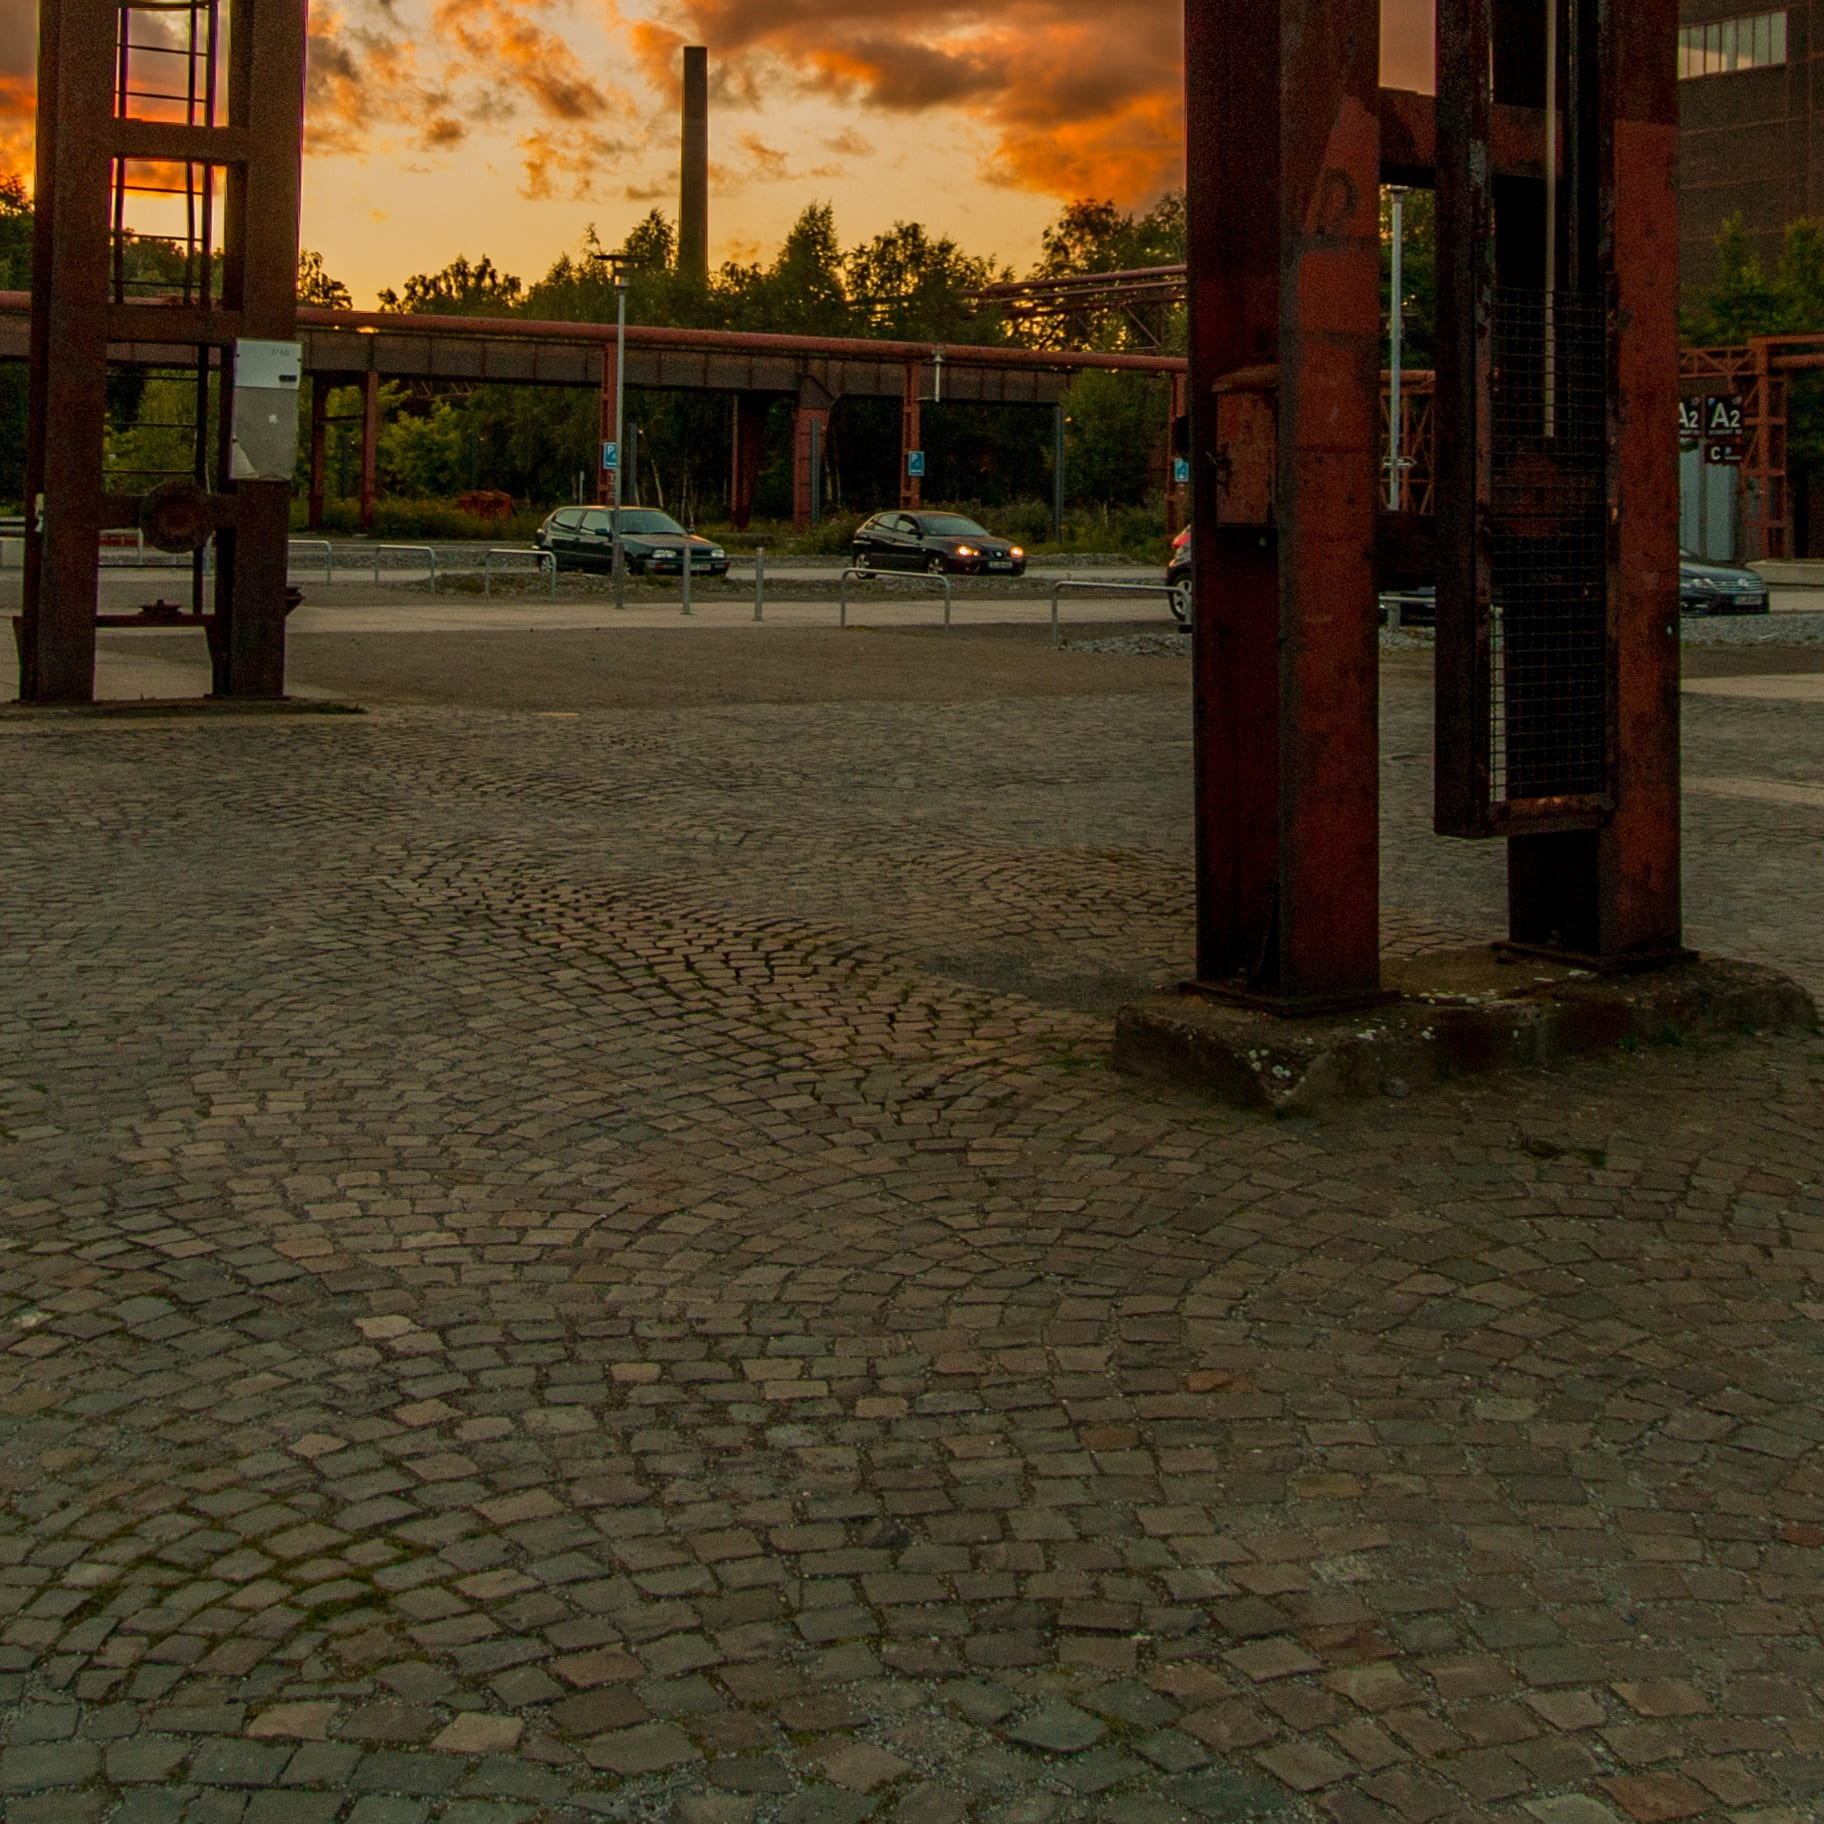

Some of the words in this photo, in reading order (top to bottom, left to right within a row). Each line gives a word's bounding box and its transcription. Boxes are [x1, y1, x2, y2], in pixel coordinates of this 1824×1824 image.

[1710, 402, 1741, 428] A2
[607, 445, 614, 455] P
[1710, 445, 1721, 461] C
